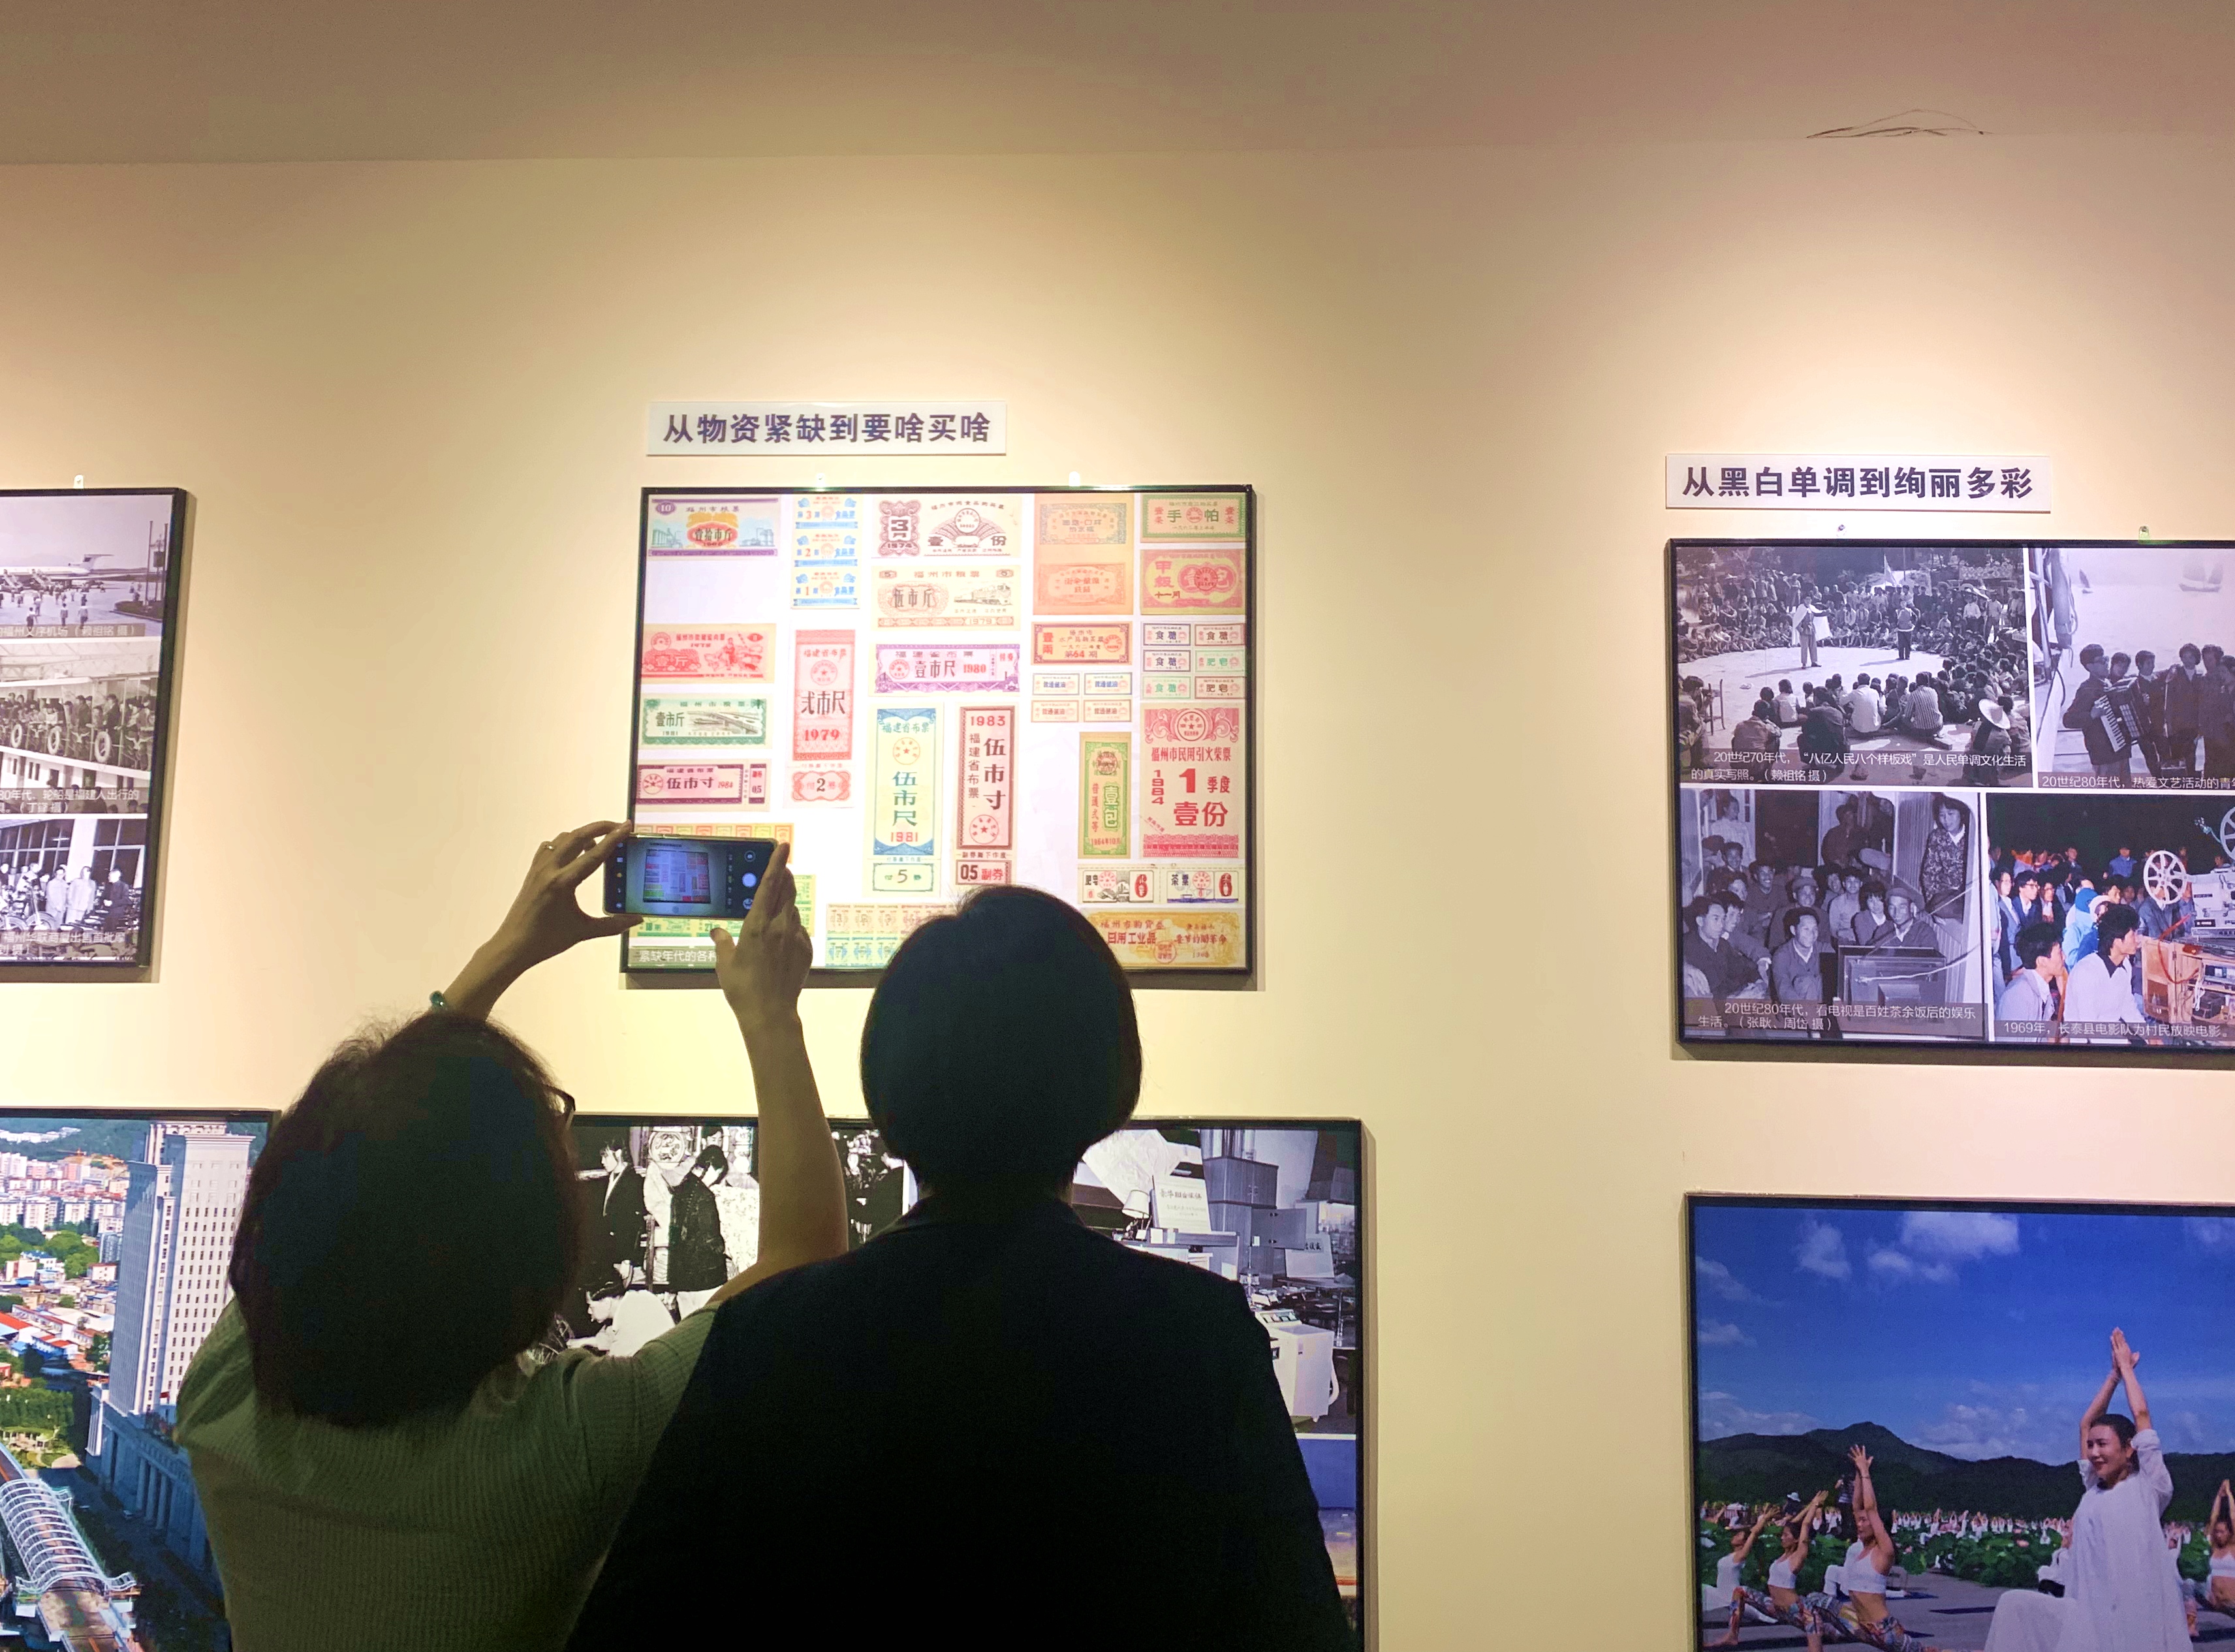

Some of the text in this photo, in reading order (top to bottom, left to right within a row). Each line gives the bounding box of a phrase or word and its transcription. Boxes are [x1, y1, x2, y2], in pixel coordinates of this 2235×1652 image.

[663, 413, 991, 443] 从物资紧缺到要啥买啥
[1682, 466, 2033, 499] 从黑白单调到绚丽多彩
[914, 661, 956, 678] 壹市尺
[963, 664, 986, 673] 1980
[971, 715, 1005, 726] 1983
[804, 729, 840, 741] 1979
[1151, 747, 1231, 762] 福州市民用引火柴票
[967, 732, 980, 799] 福建省布票
[983, 738, 1007, 811] 伍市寸
[666, 777, 715, 789] 伍市寸
[1151, 770, 1164, 805] 1984
[1207, 775, 1230, 794] 季度
[891, 771, 918, 826] 伍市尺
[1103, 785, 1119, 828] 壹包
[1173, 801, 1228, 827] 壹份
[890, 832, 918, 842] 1981
[981, 868, 1004, 881] 副券
[1107, 931, 1157, 944] 日用工业品
